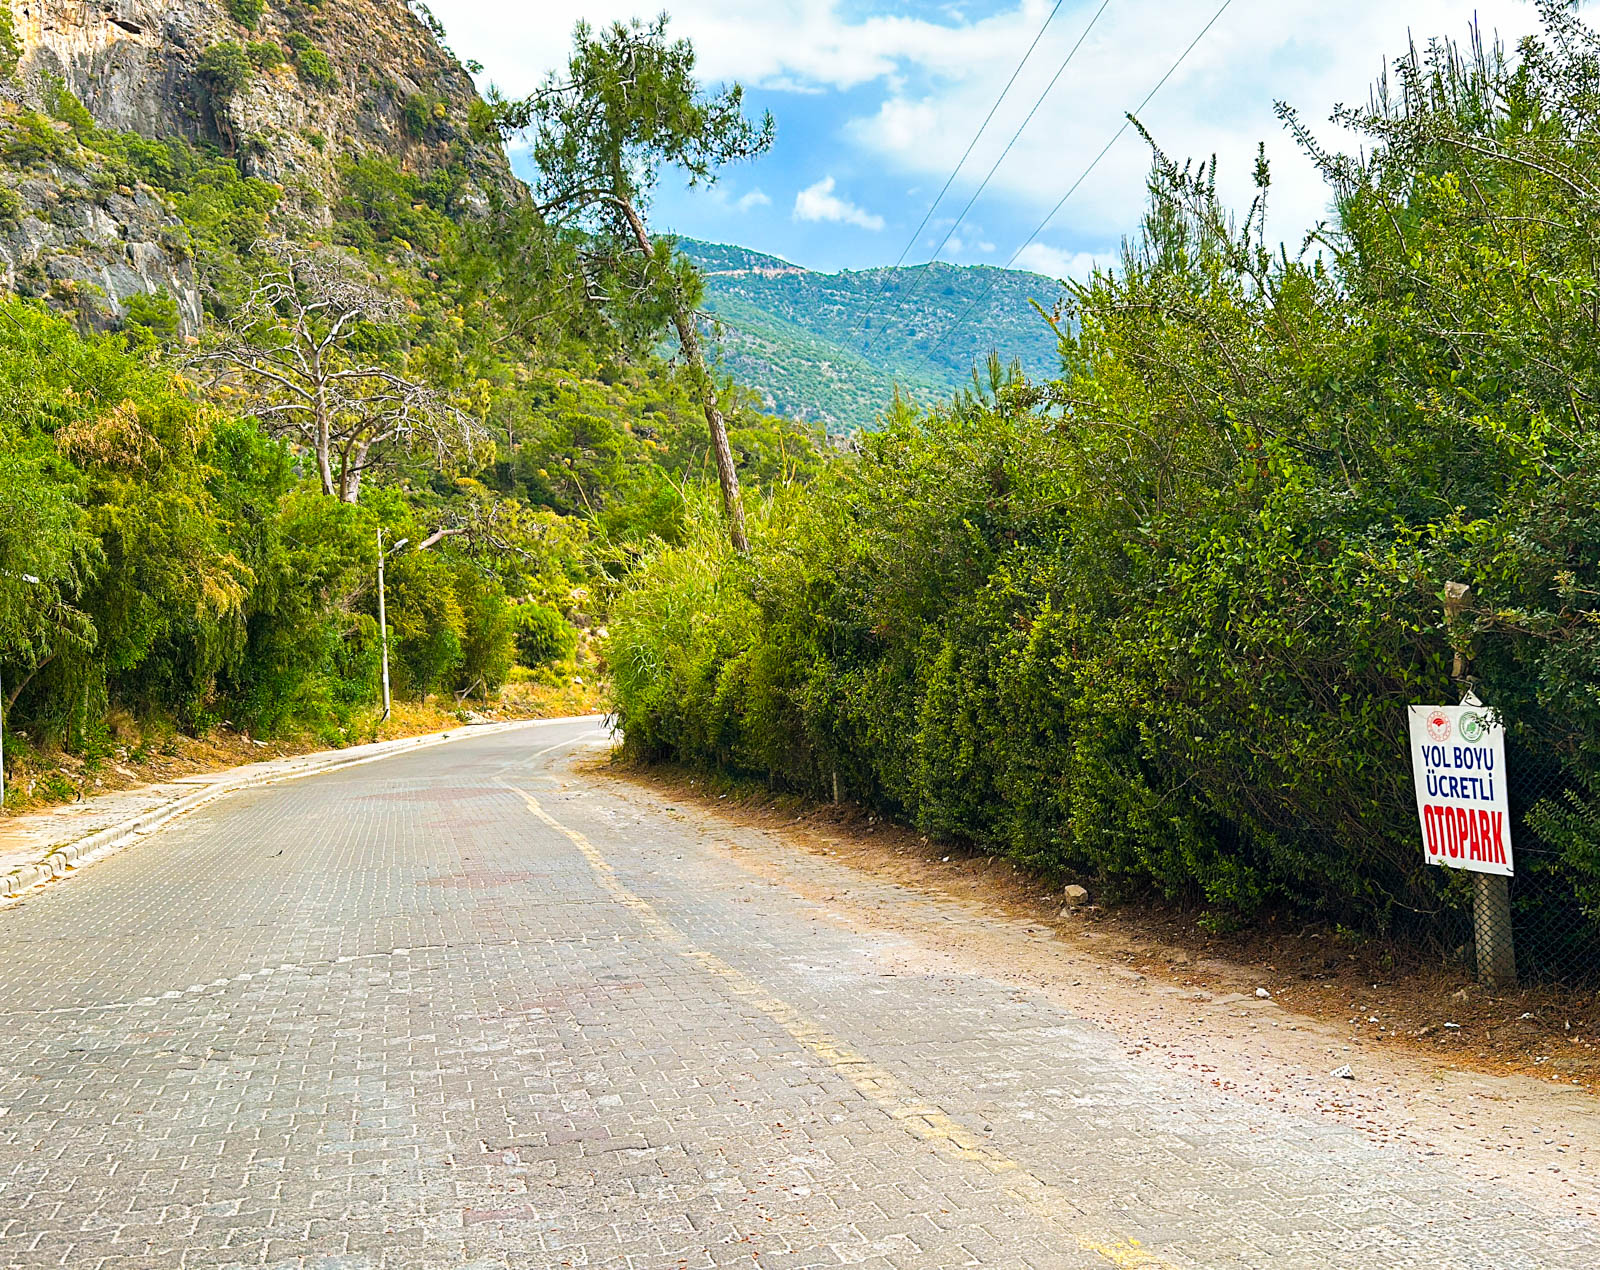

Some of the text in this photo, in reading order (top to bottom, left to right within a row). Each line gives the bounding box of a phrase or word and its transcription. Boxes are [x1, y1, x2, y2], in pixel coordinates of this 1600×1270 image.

[1421, 745, 1494, 771] YOL BOYU
[1426, 769, 1494, 801] ÜCRETLİ
[1423, 804, 1507, 865] OTOPARK
